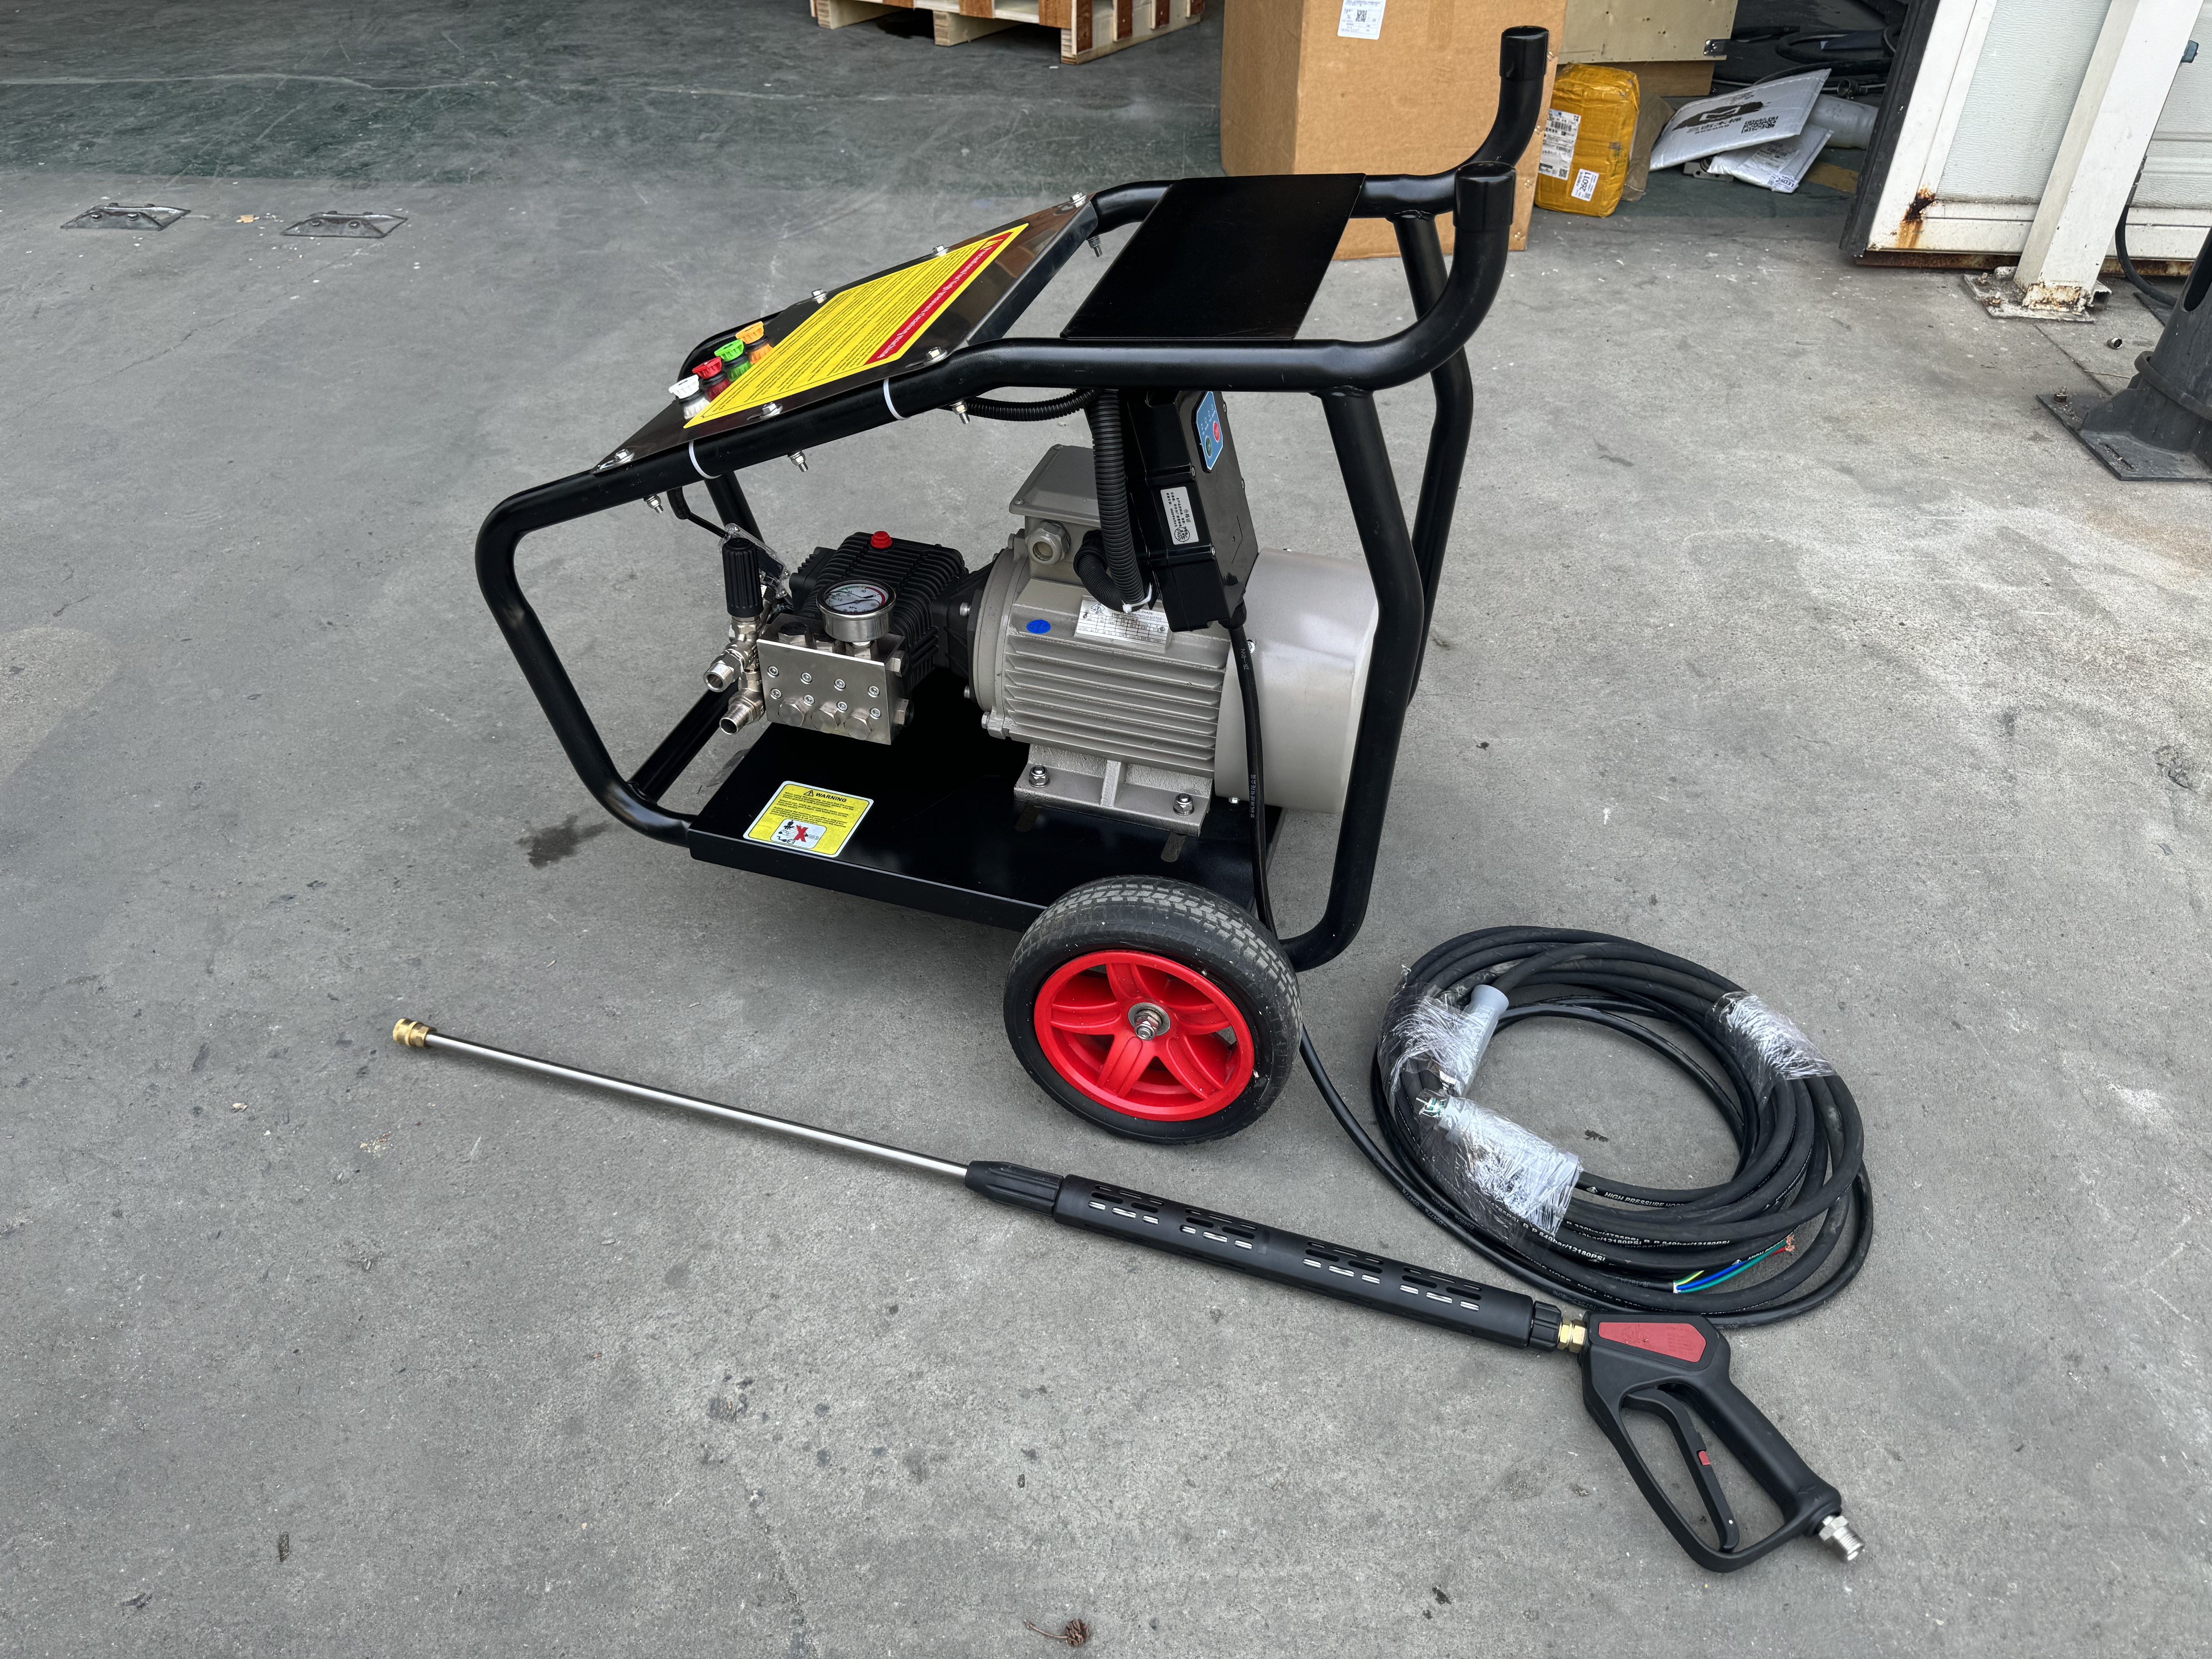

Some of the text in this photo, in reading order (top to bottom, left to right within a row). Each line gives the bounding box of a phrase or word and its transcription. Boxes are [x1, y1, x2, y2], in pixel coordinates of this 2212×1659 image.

[1580, 172, 1591, 192] 26011
[816, 792, 847, 802] WARNING
[1604, 1192, 1625, 1201] HIGH
[1624, 1197, 1665, 1208] PRESSURE
[1539, 1231, 1606, 1262] 840bar/12180PSI
